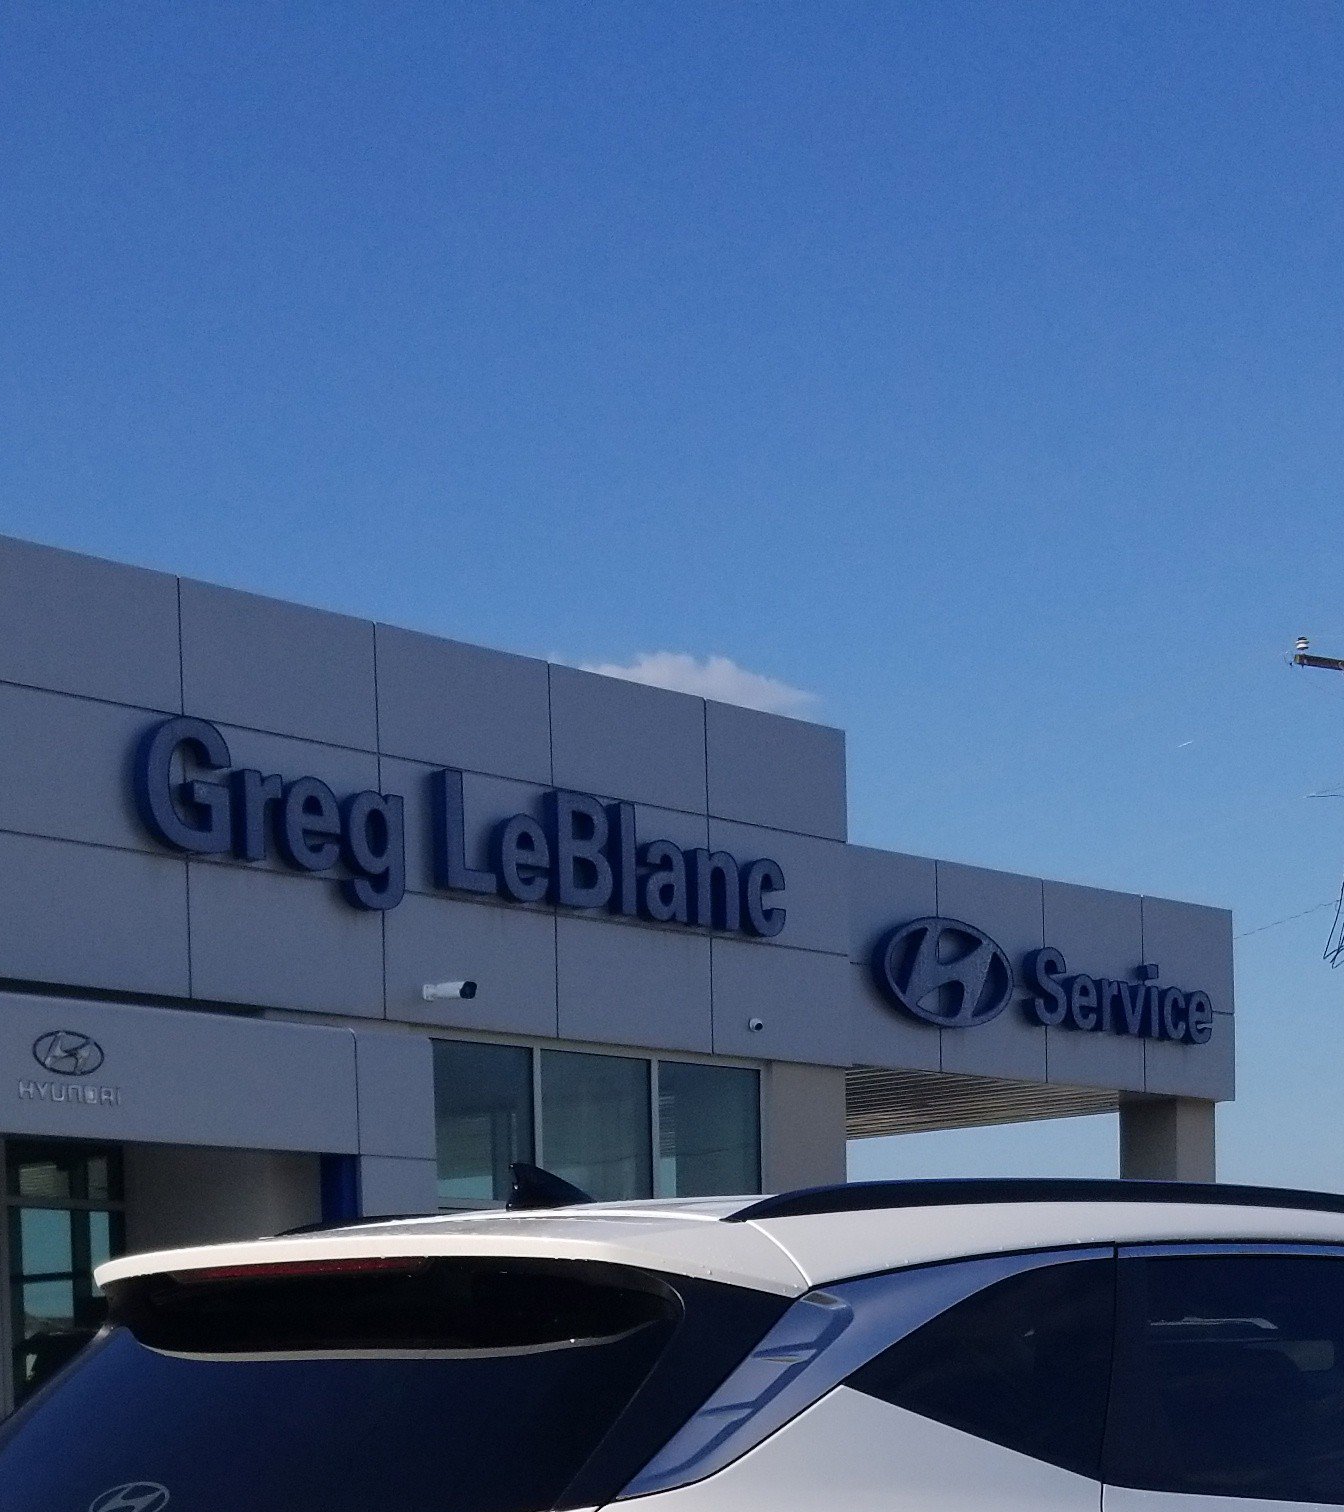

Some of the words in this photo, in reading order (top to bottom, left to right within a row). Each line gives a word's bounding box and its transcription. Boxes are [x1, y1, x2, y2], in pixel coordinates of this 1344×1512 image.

[132, 716, 406, 911] Greg
[428, 767, 787, 938] LeBlanc
[1021, 945, 1214, 1045] Service
[18, 1080, 122, 1105] HYUNDAI
